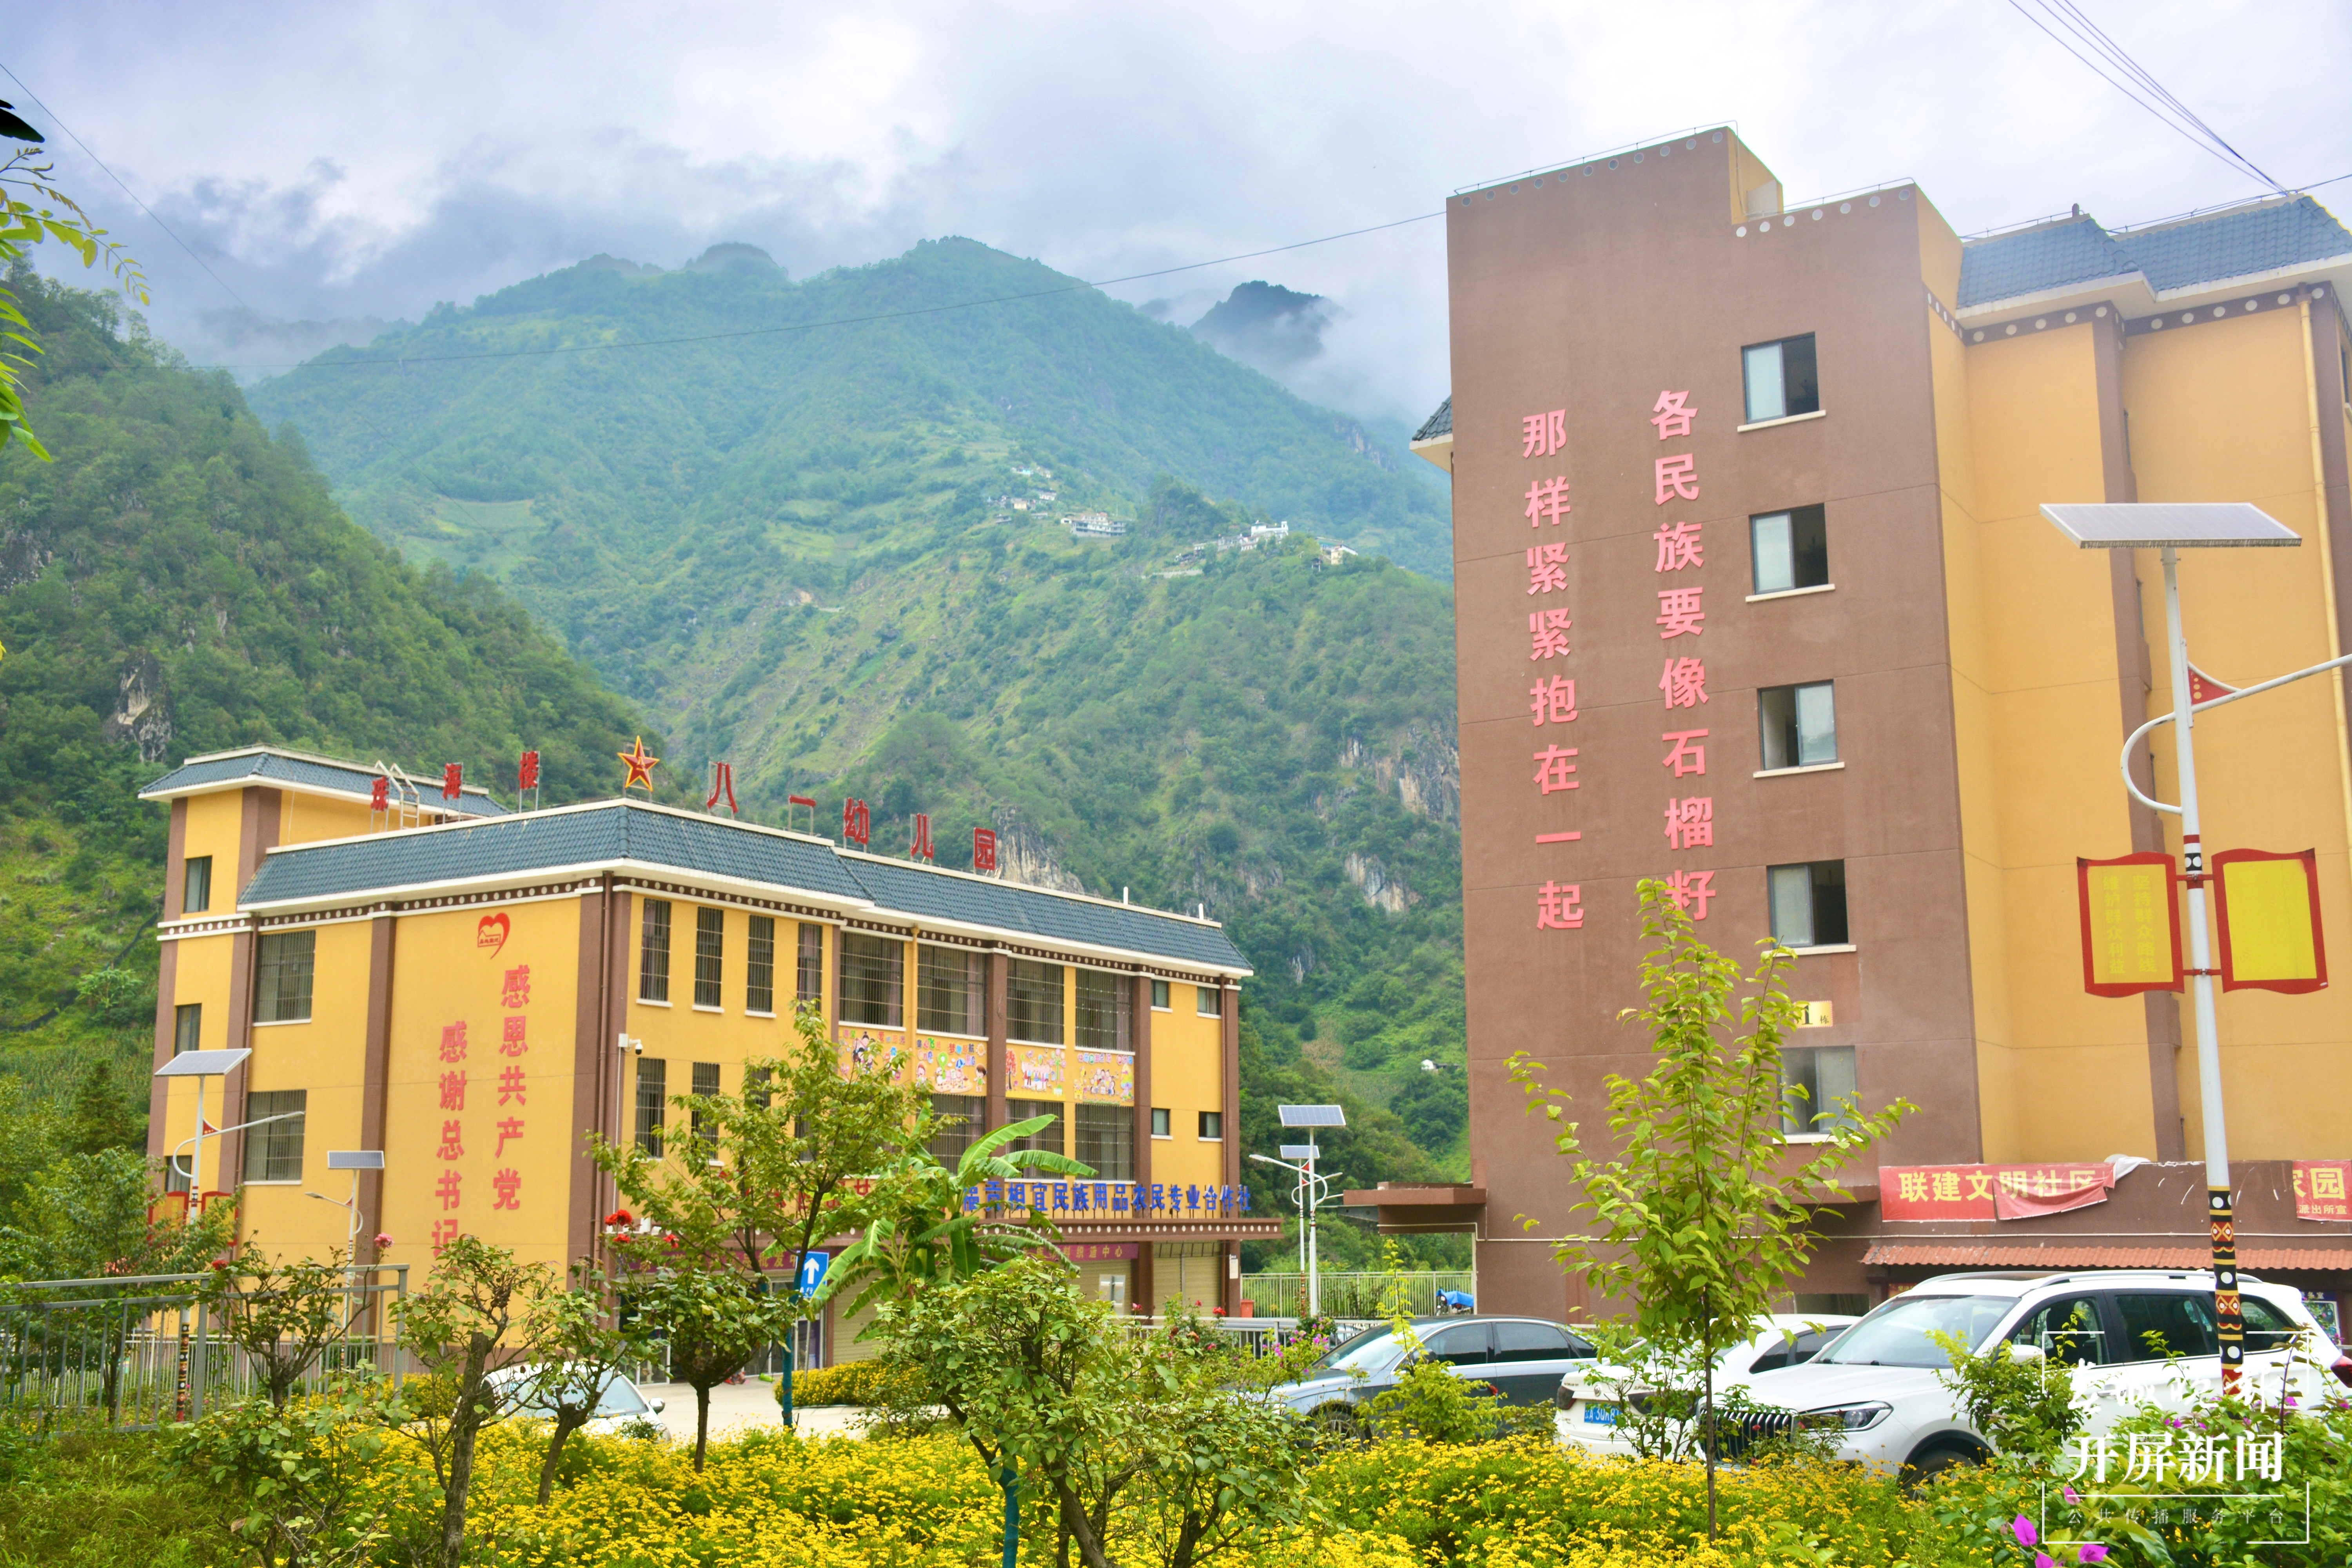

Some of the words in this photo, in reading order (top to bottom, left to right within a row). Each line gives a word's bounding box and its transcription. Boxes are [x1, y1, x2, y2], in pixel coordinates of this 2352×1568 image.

[1523, 409, 1584, 930] 那样紧紧抱在一起
[1650, 390, 1716, 921] 各民族要像石榴籽
[707, 761, 996, 871] 八一幼儿园
[2103, 875, 2125, 974] 维护群众利益
[2133, 875, 2157, 973] 坚持群众路线
[432, 1020, 468, 1259] 感谢总书记
[493, 965, 530, 1210] 感恩共产党
[1898, 1170, 2096, 1203] 联建文明社区
